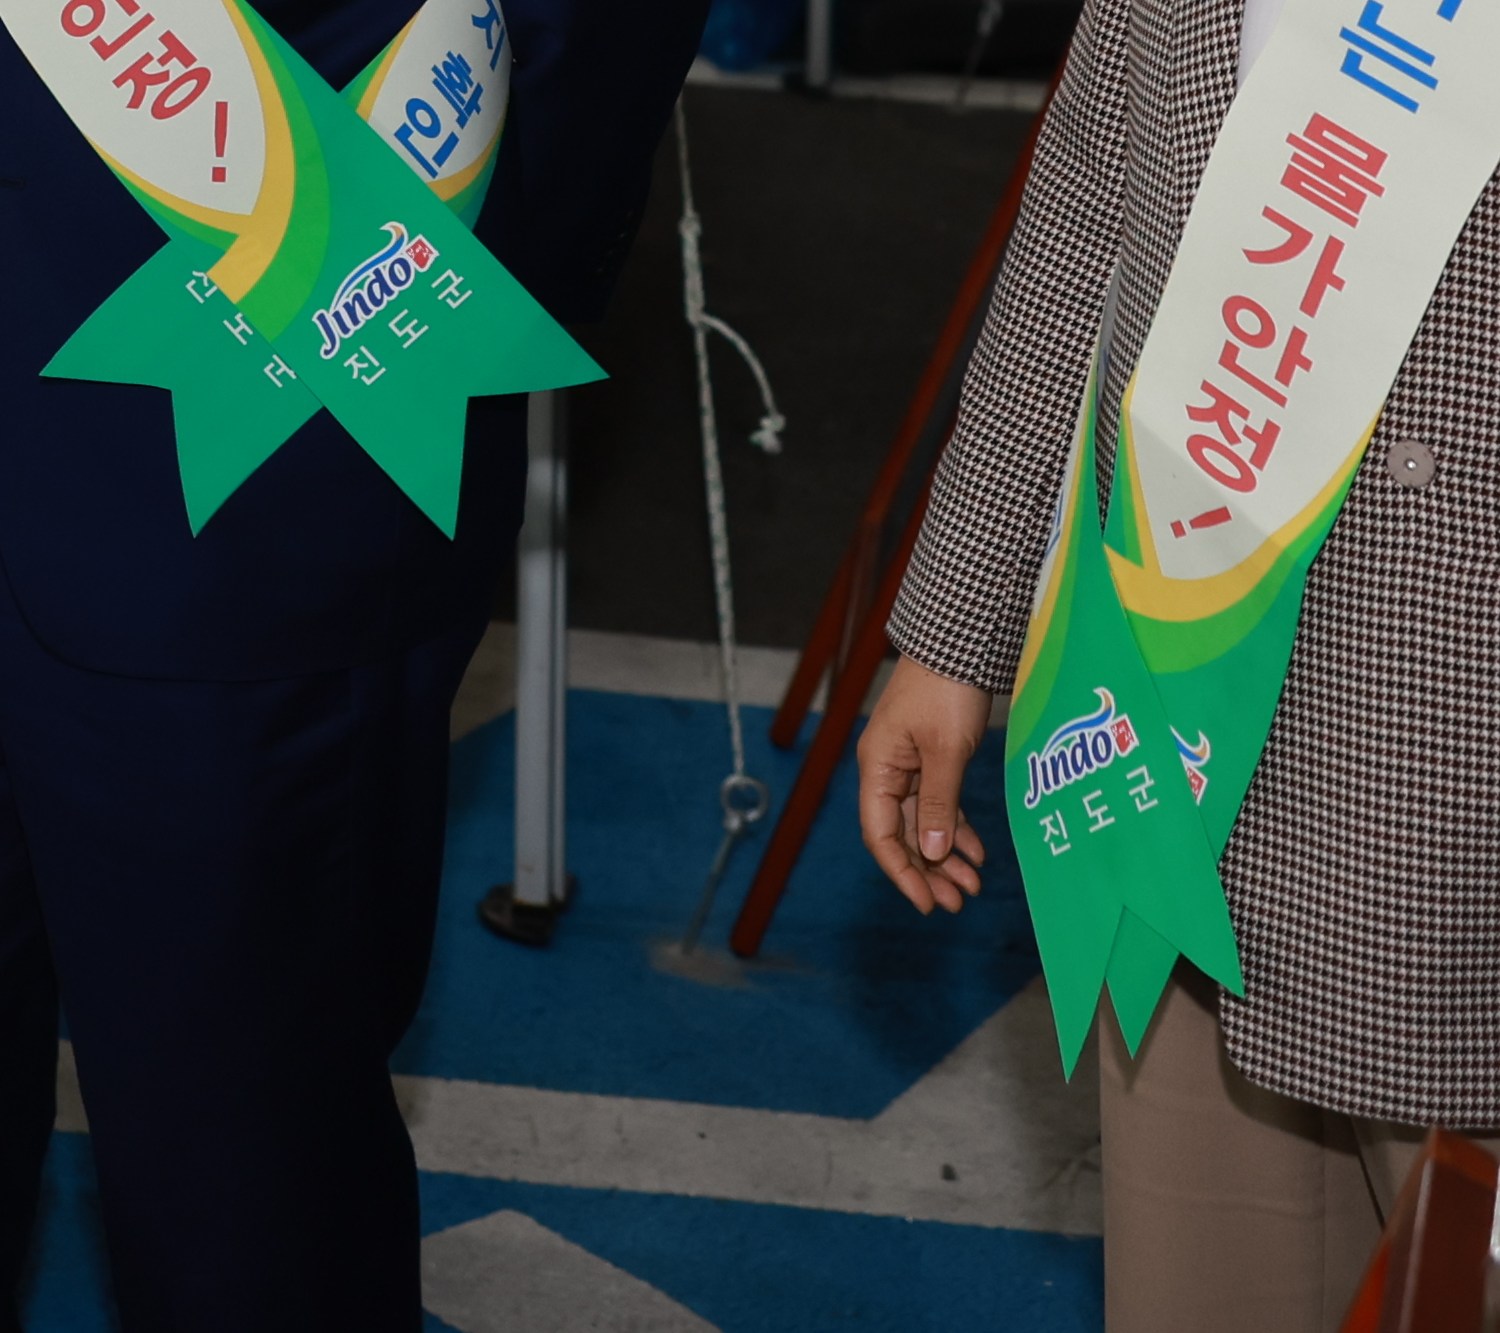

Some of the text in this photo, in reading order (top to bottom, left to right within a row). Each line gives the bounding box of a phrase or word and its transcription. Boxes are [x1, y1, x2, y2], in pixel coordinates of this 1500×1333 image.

[311, 253, 415, 360] Jindo
[343, 268, 474, 386] 진도군
[1170, 112, 1387, 539] 물가안정!
[1024, 727, 1114, 809] Jindo
[1039, 764, 1159, 887] 진도군
